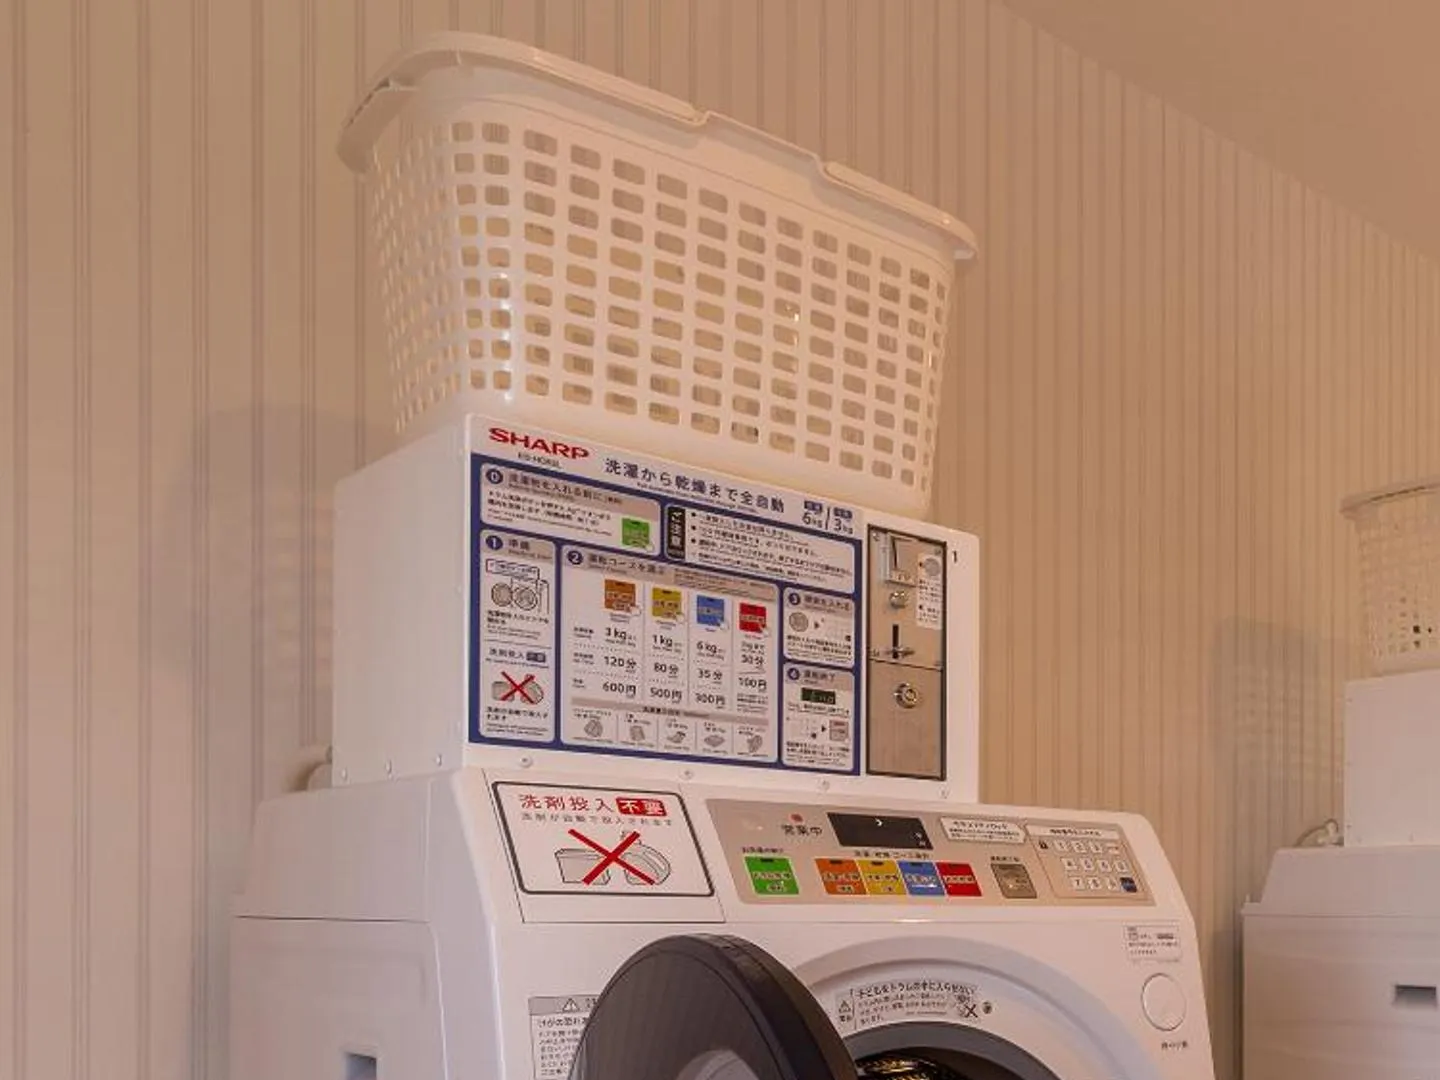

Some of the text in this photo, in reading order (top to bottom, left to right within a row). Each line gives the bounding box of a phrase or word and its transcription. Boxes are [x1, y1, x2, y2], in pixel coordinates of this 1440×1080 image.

[489, 427, 590, 460] SHARP
[604, 457, 785, 514] 洗濯から乾燥まで全自動
[603, 655, 637, 670] 120分
[653, 661, 679, 676] 80分
[602, 681, 637, 697] 600円
[738, 676, 768, 692] 100円
[650, 686, 683, 701] 500円
[519, 793, 666, 816] 洗剤投入 不要
[782, 824, 823, 838] 営業中
